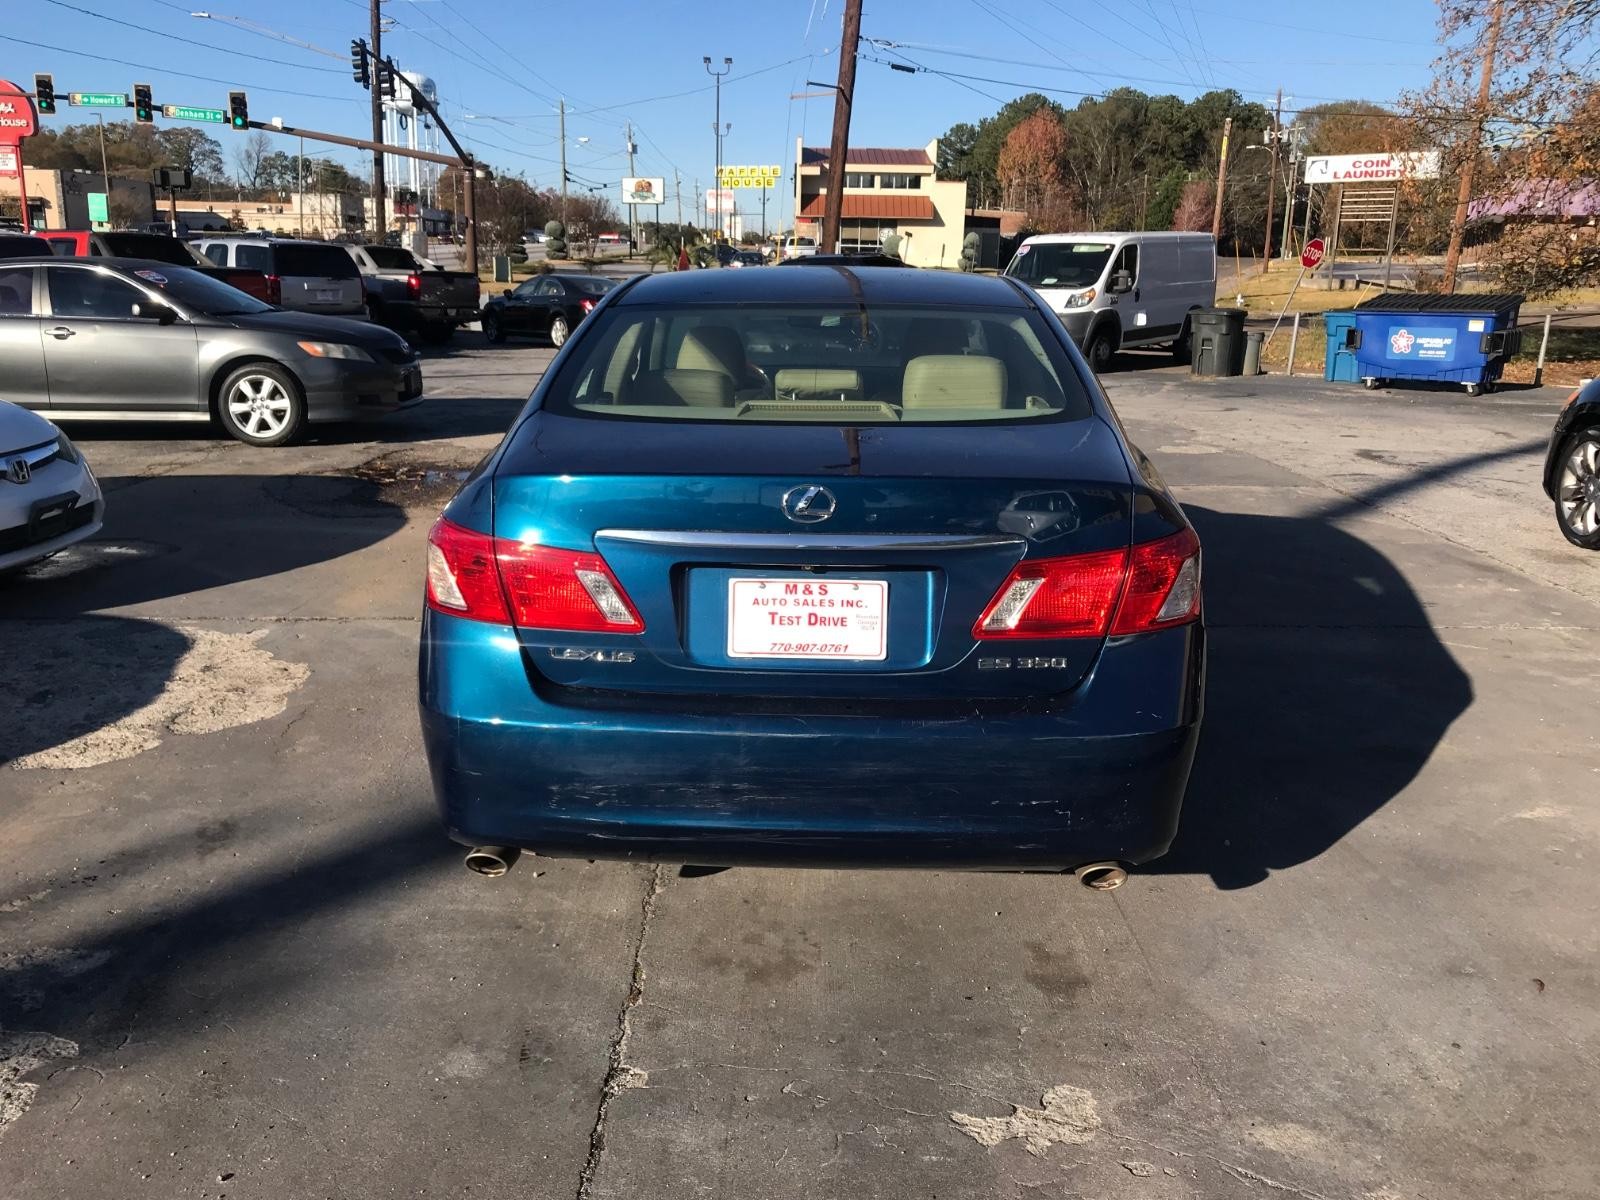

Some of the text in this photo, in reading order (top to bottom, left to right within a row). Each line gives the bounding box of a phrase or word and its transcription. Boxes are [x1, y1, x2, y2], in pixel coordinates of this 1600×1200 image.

[89, 95, 124, 105] Howard St
[175, 108, 214, 120] Denham St
[1352, 159, 1391, 168] COIN
[716, 167, 780, 177] WAFFLE
[1333, 169, 1408, 179] LAUNDRY
[722, 178, 774, 187] HOUSE
[1303, 246, 1323, 261] STOP
[785, 583, 829, 596] M & S
[752, 597, 869, 609] AUTO SALES INC.
[768, 611, 848, 627] TEST DRIVE
[770, 642, 849, 653] 770-907-0761
